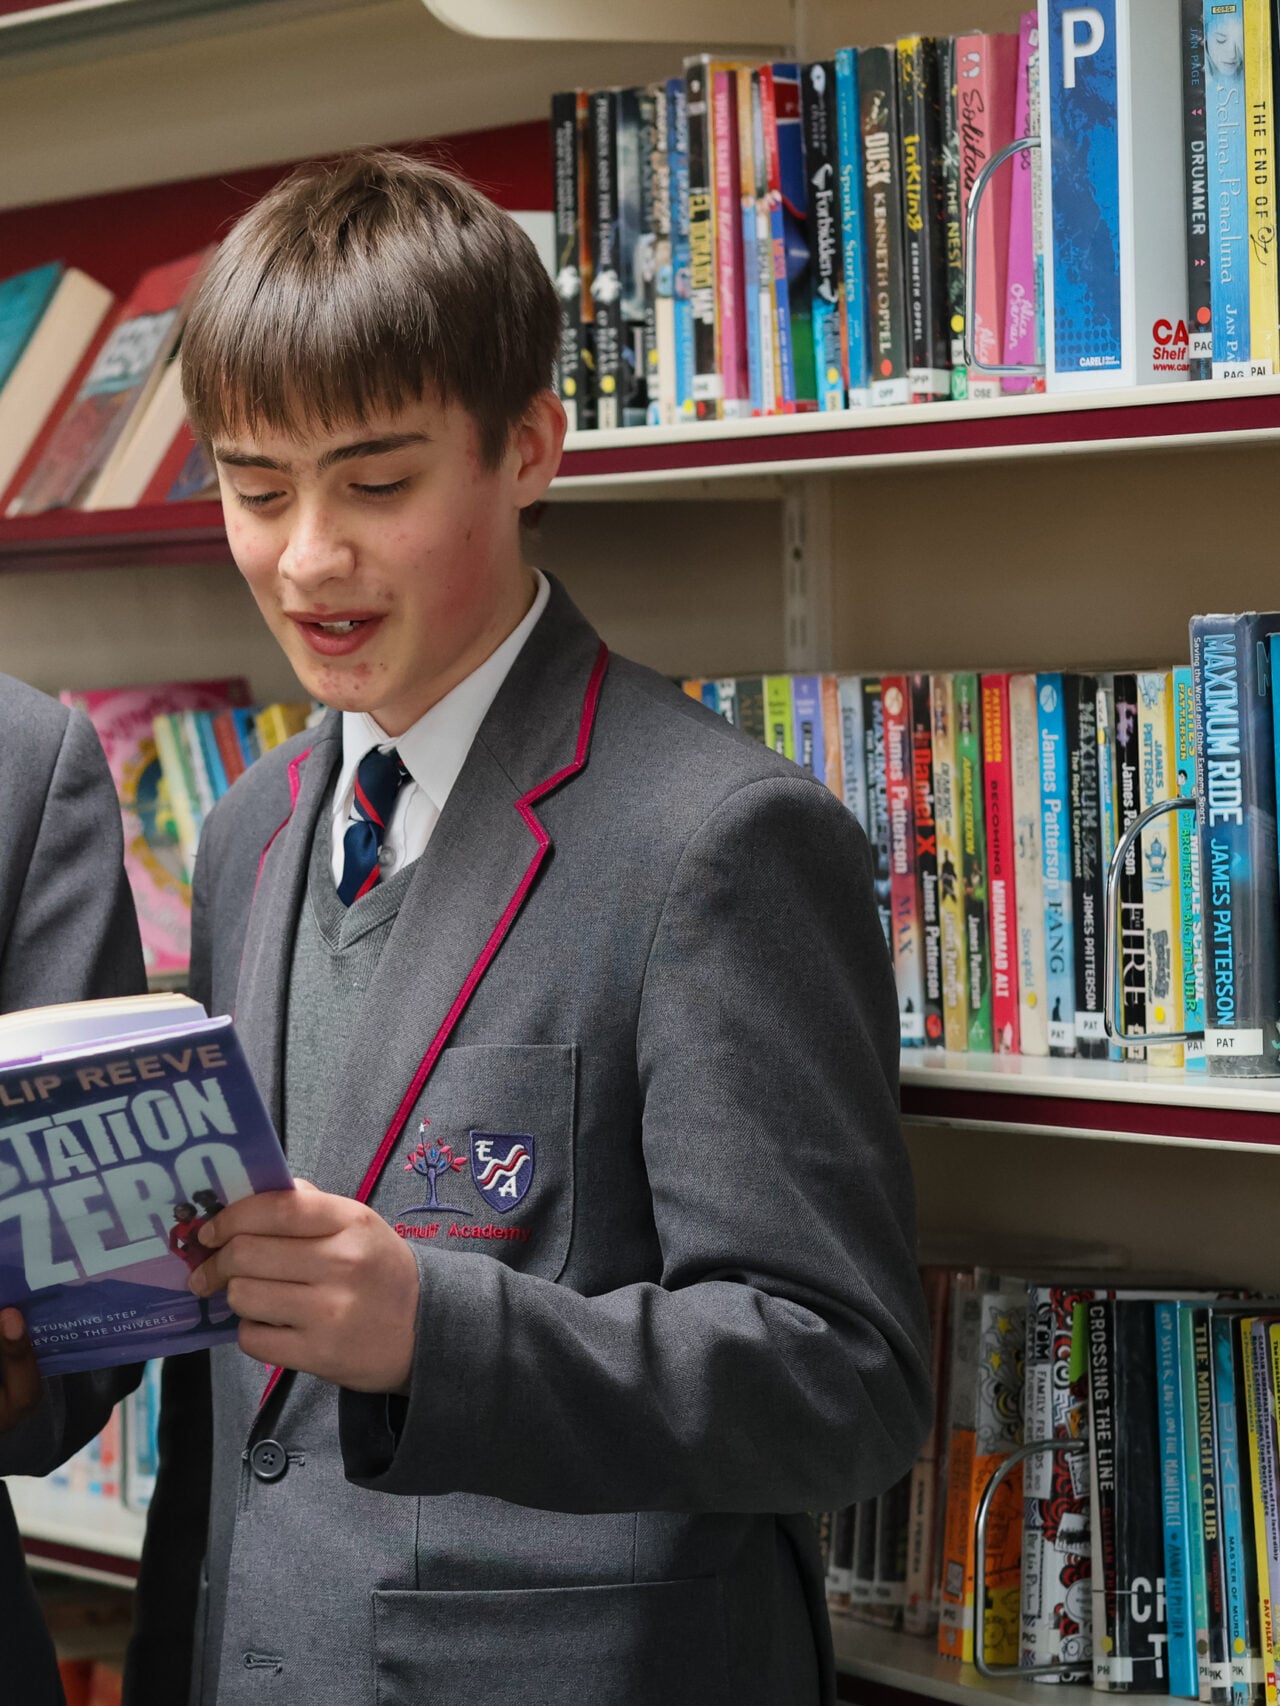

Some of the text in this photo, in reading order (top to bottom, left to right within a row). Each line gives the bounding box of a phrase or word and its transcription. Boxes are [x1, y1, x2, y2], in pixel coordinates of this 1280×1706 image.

[1061, 7, 1106, 89] P
[1190, 27, 1200, 86] JAN PAGE
[840, 164, 855, 233] Spooky
[904, 134, 924, 232] Inkling
[1190, 141, 1207, 236] DRUMMER
[1253, 101, 1269, 219] THE END OF
[815, 190, 840, 277] Forbidden
[865, 131, 892, 354] DUSK KENNETH OPPEL
[947, 182, 962, 269] THE NEST
[1218, 178, 1242, 285] Penaluna
[845, 239, 858, 304] Stories
[1153, 347, 1186, 361] Shelf
[1225, 304, 1239, 362] JAN PA
[992, 688, 1002, 763] PATTERSON
[1079, 702, 1099, 827] MAXIMUM
[1143, 723, 1156, 808] PATTERSON
[1154, 740, 1165, 789] JAMES
[1178, 684, 1188, 760] PATTERSON
[1191, 636, 1206, 825] Saving the World and Other Extreme Sports
[1201, 633, 1243, 828] MAXIMUM RIDE
[913, 747, 937, 857] Daniel X
[1070, 749, 1083, 879] The Angel Experiment
[1122, 763, 1137, 808] James
[886, 720, 915, 956] James Patterson MAX
[1042, 728, 1065, 976] James Patterson FANG
[1181, 829, 1193, 889] BROTHER
[991, 780, 1009, 998] BECOMING MUHAMMAD ALI
[1209, 838, 1236, 1026] JAMES PATTERSON
[922, 871, 942, 999] James Patterson
[967, 914, 984, 1009] James Patterson
[1082, 892, 1097, 1011] JAMES PATTERSON
[1121, 901, 1147, 1007] FIRE
[76, 1043, 229, 1092] REEVE
[1083, 1020, 1098, 1030] PAT
[1217, 1038, 1236, 1049] PAT
[498, 1176, 518, 1198] A
[447, 1223, 534, 1243] Academy
[32, 1309, 139, 1334] STUNNING STEP
[84, 1325, 110, 1338] THE
[112, 1313, 178, 1334] UNIVERSE
[1036, 1370, 1048, 1414] FAMILY
[1089, 1306, 1112, 1440] CROSSING THE
[1195, 1323, 1217, 1541] THE MIDNIGHT CLUB
[1228, 1536, 1241, 1639] MASTER OF MURD
[1263, 1599, 1274, 1655] DAV PILKEY
